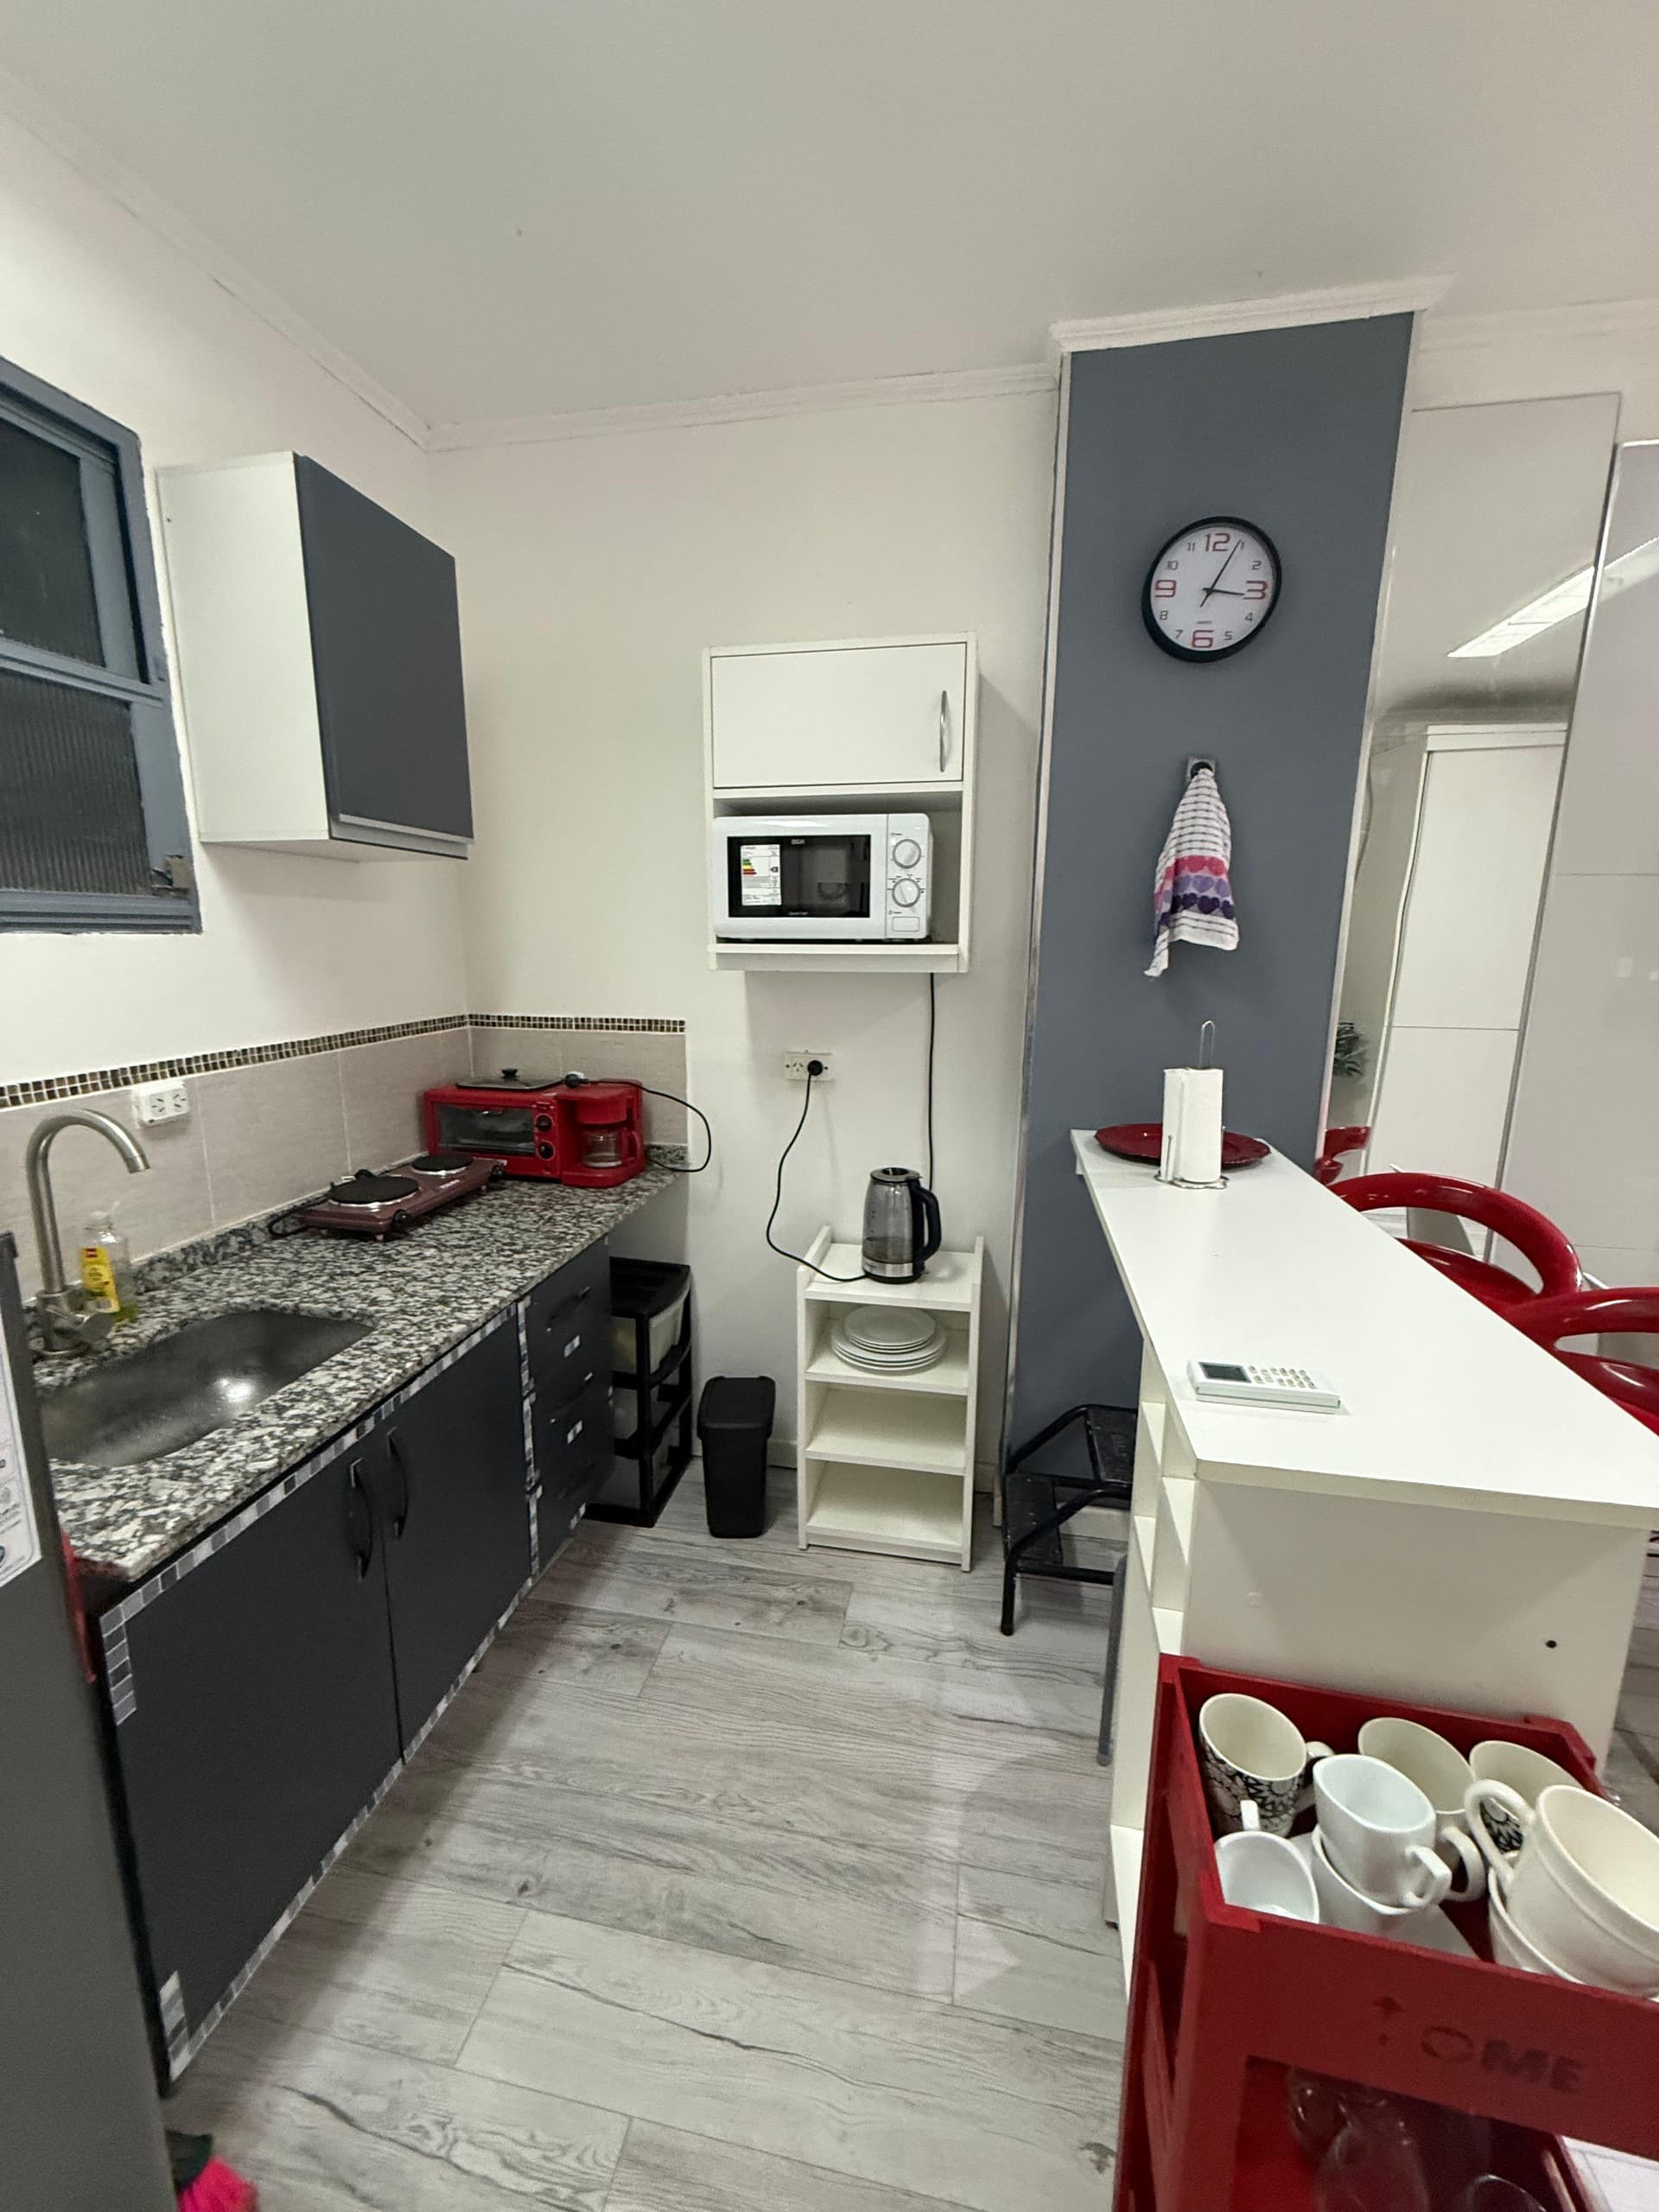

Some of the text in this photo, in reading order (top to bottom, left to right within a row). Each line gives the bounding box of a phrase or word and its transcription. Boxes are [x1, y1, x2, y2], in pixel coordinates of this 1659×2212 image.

[1186, 542, 1196, 551] 11
[1205, 532, 1230, 552] 12
[1240, 541, 1244, 550] 1
[1166, 560, 1179, 570] 10
[1251, 561, 1262, 570] 2
[1154, 579, 1177, 598] 9
[1243, 580, 1268, 600] 3
[1160, 610, 1168, 620] 8
[1244, 612, 1253, 621] 4
[1175, 629, 1183, 639] 7
[1191, 629, 1214, 648] 6
[1224, 631, 1233, 640] 5
